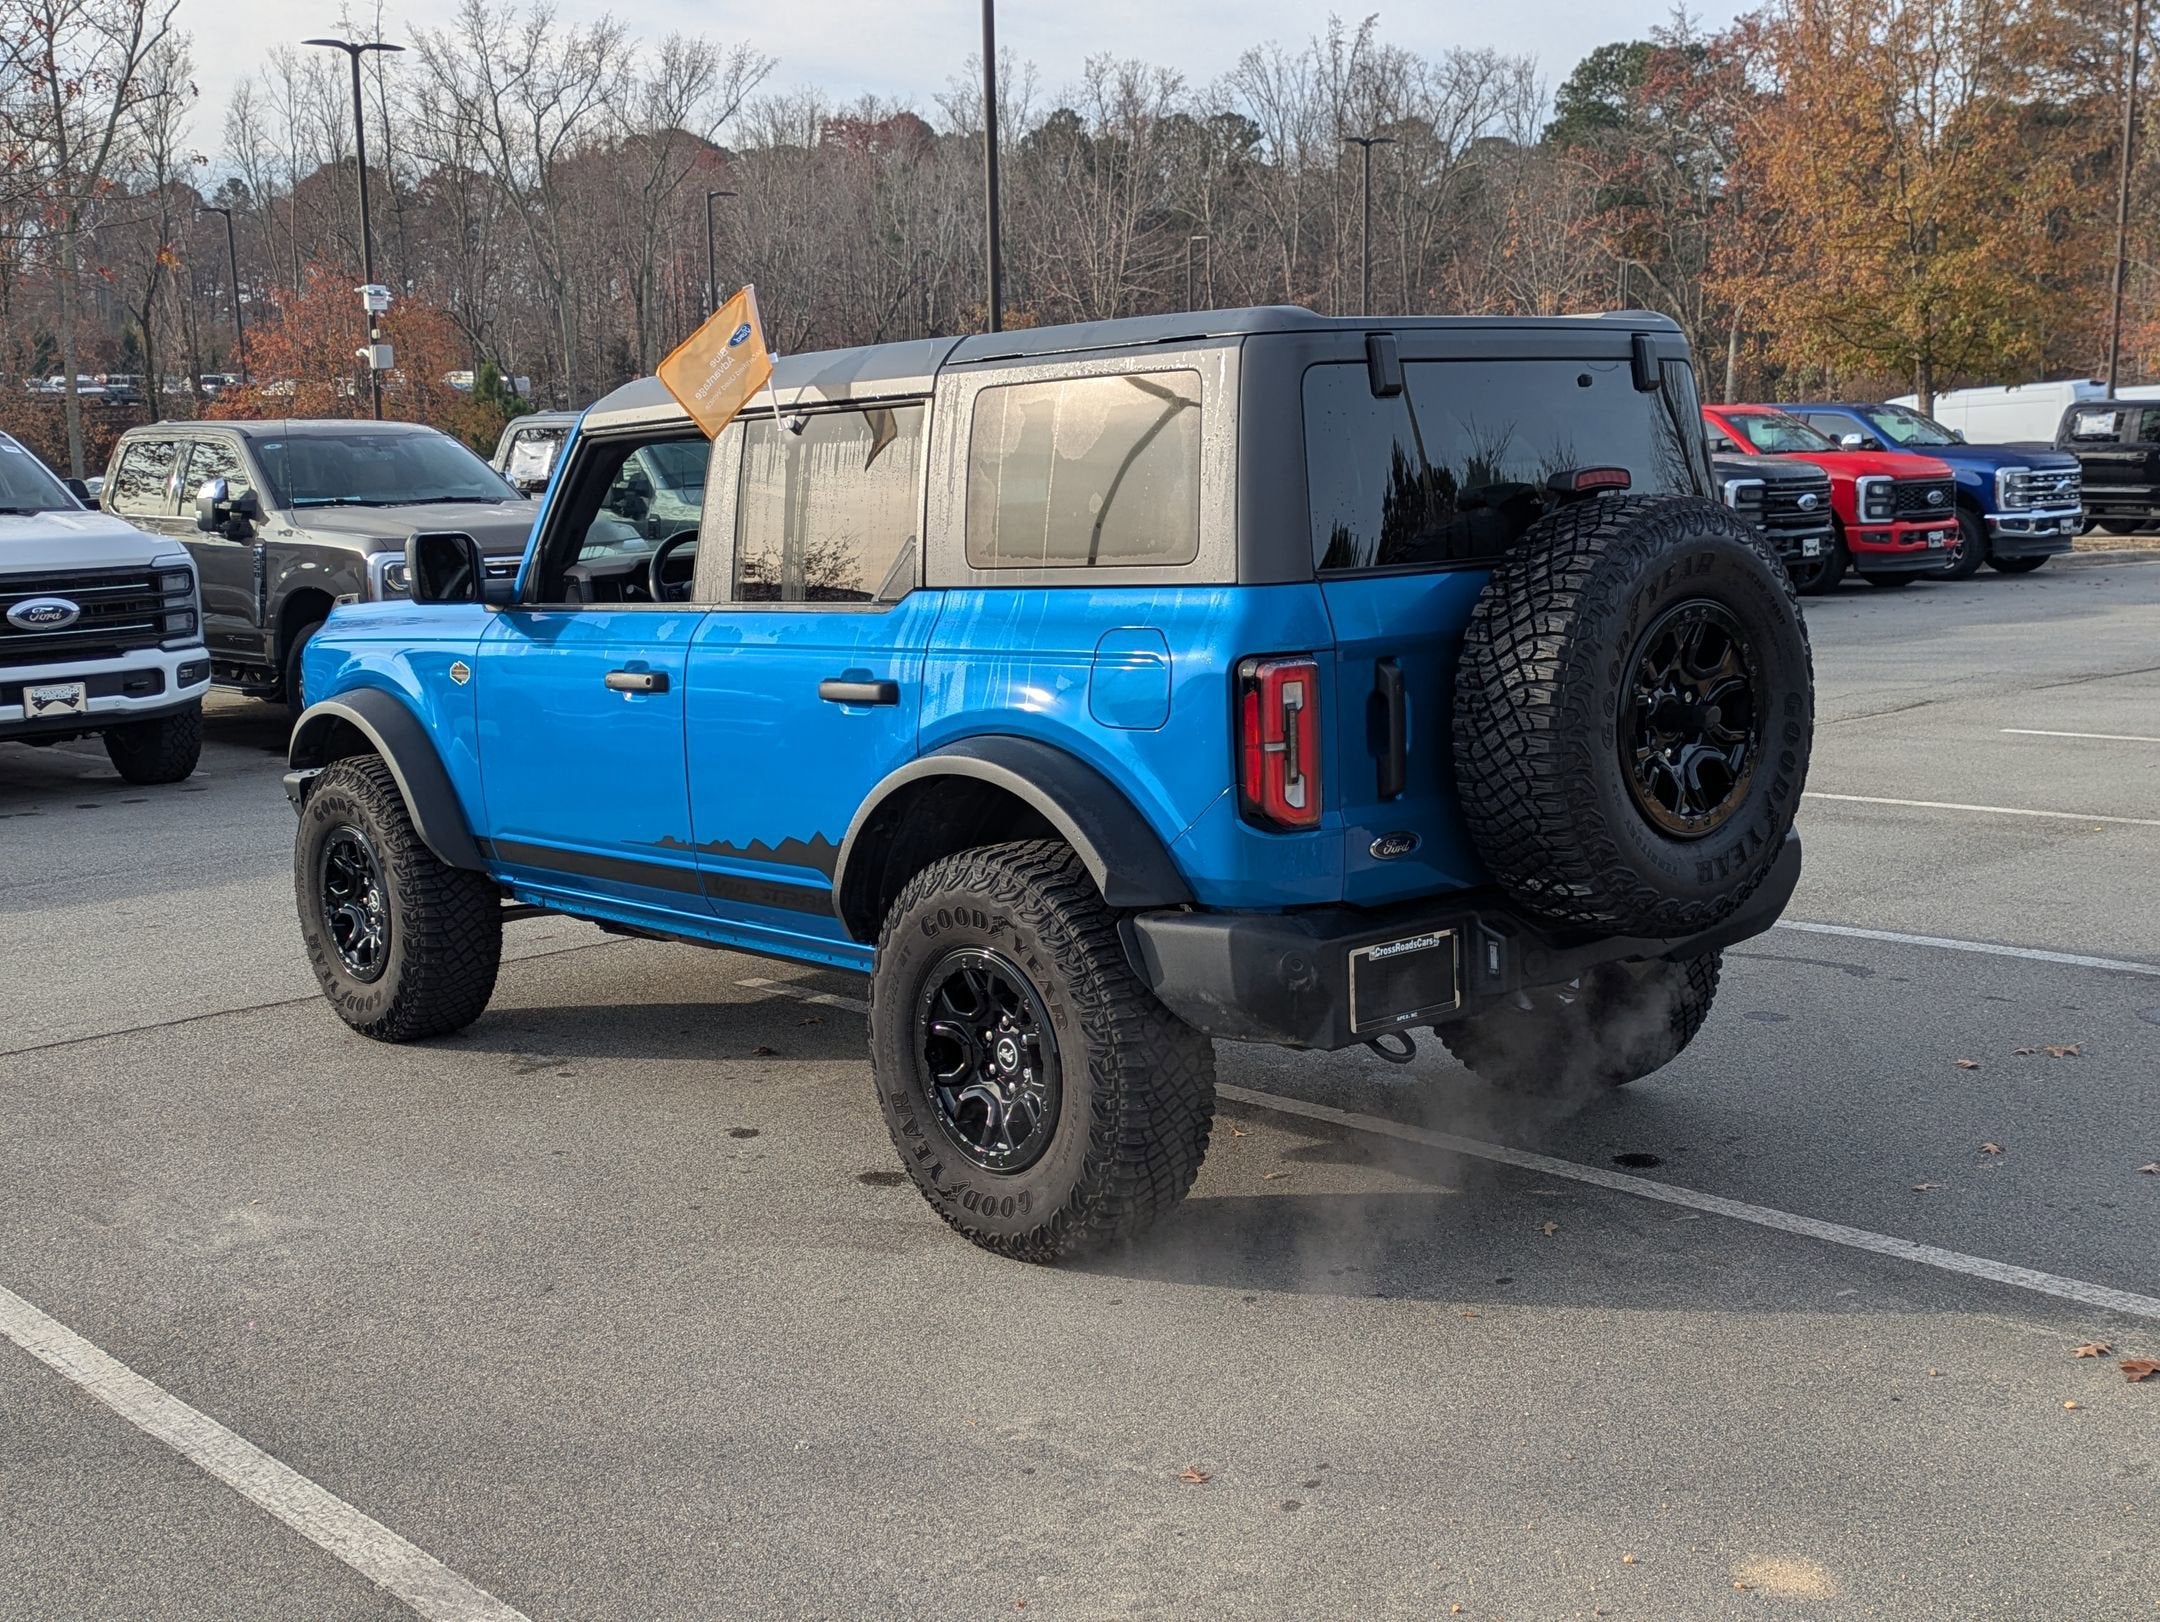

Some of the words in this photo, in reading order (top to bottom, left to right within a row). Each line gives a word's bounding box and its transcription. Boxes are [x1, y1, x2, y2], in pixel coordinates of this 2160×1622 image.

[29, 606, 63, 622] Ford
[1381, 839, 1411, 855] Ford
[1374, 937, 1434, 958] CrossRoadsCars
[920, 905, 1069, 1033] GOODYEAR
[891, 1090, 1033, 1220] GOODYEAR
